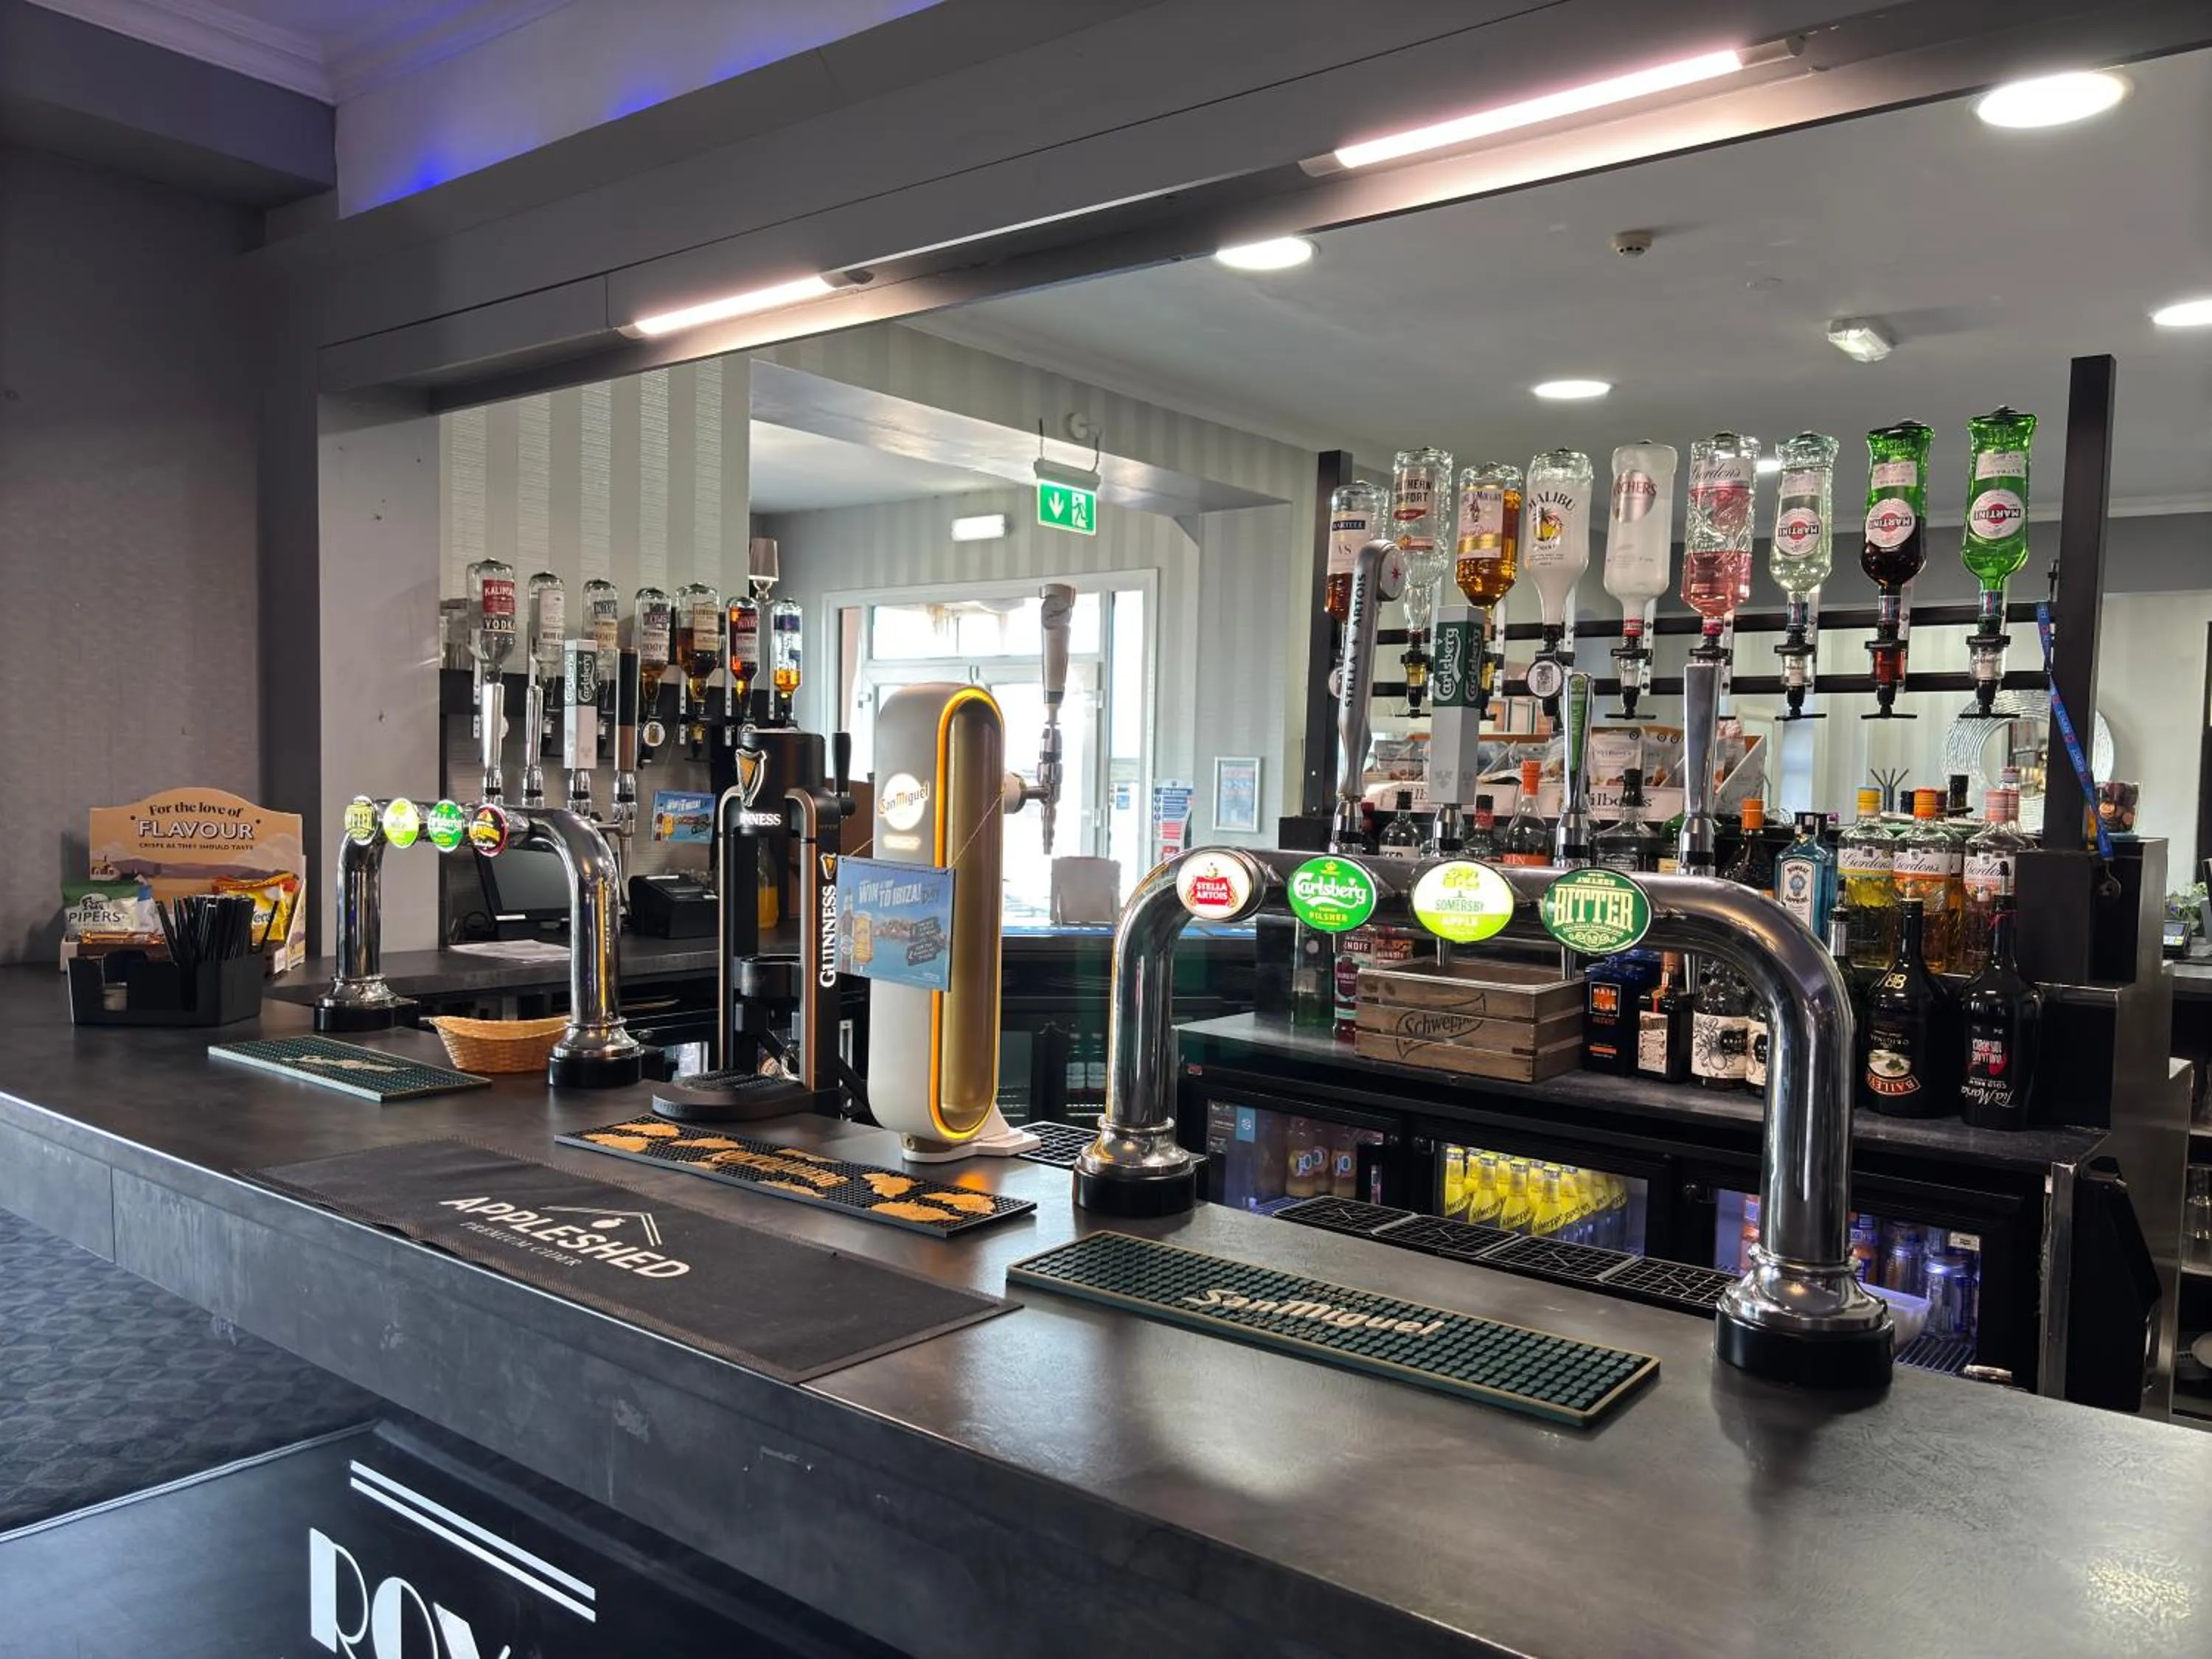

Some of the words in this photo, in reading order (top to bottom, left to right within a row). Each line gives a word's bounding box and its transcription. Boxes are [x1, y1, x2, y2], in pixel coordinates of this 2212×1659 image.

[1868, 515, 1913, 529] MARTINI
[1973, 508, 2020, 520] MARTINI
[1778, 524, 1820, 537] MARTINI
[1351, 574, 1366, 628] ARTOIS
[1434, 627, 1460, 701] Carlsberg
[150, 805, 170, 815] For
[175, 802, 197, 813] the
[199, 803, 224, 815] love
[227, 807, 243, 817] of
[138, 820, 254, 840] FLAVOUR
[1894, 853, 1941, 872] Gordon's
[1196, 882, 1227, 891] STELLA
[1197, 891, 1227, 900] ARTOIS
[1293, 872, 1368, 908] Carlsberg
[1435, 899, 1484, 912] SOMERSBY
[1552, 886, 1634, 933] BITTER
[69, 911, 119, 922] PIPERS
[820, 883, 837, 987] GUINNESS
[439, 1197, 690, 1278] APPLESHED
[460, 1222, 532, 1248] PREMIUM
[529, 1246, 582, 1267] CIDER
[1181, 1289, 1278, 1315] San
[1273, 1299, 1445, 1336] Miguel
